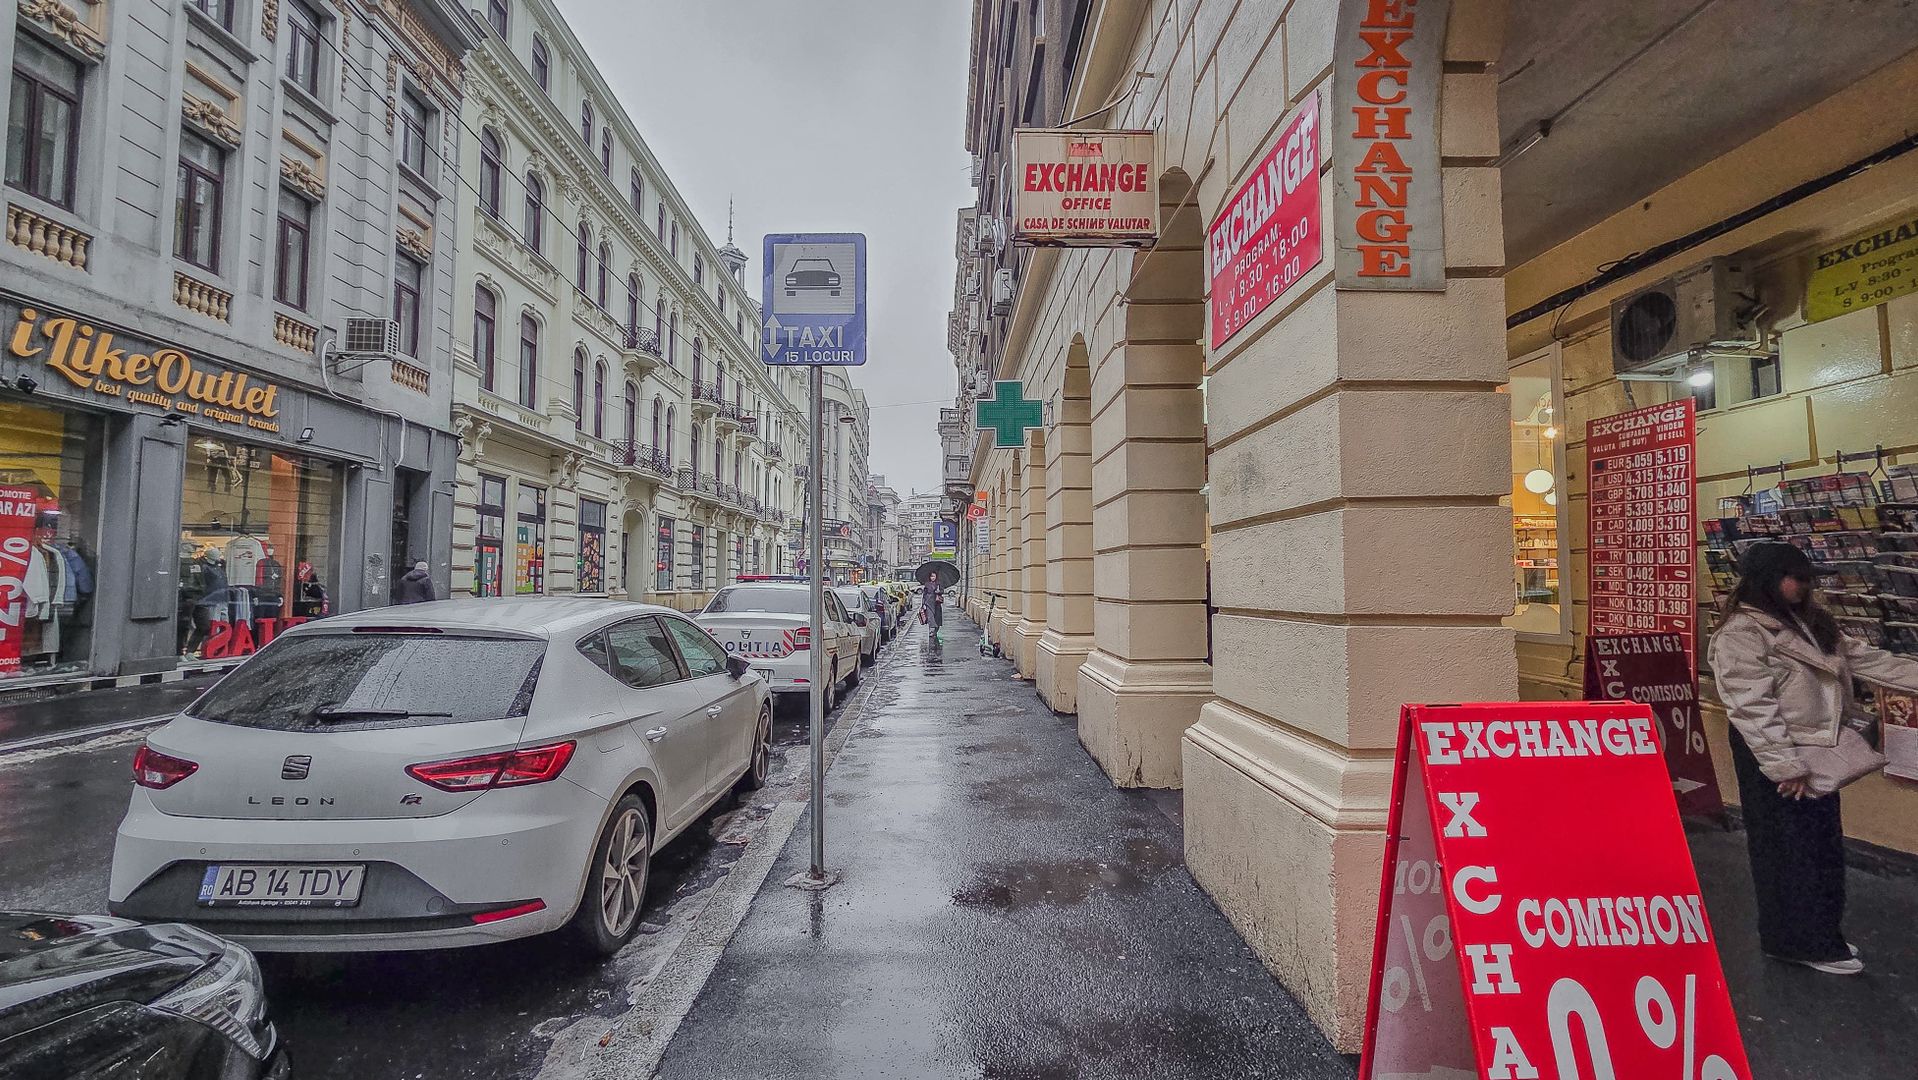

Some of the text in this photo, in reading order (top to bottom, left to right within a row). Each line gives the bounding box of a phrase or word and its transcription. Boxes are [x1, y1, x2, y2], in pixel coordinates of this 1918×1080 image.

[1352, 0, 1415, 277] EXCHANGE
[1024, 163, 1148, 193] EXCHANGE
[1212, 108, 1316, 278] EXCHANGE
[1062, 197, 1112, 210] OFFICE
[1024, 217, 1151, 230] CASA DE SCHIMB VALUTAR
[1240, 262, 1262, 298] 8:30
[1272, 216, 1308, 265] 18:00
[1224, 318, 1230, 335] S
[1234, 295, 1256, 328] 9:00
[1266, 255, 1300, 300] 16:00
[1842, 297, 1852, 308] S
[1860, 286, 1894, 303] 9:00
[783, 325, 843, 348] TAXI
[784, 350, 854, 363] 15 LOCURI
[95, 380, 280, 433] best quality and original brands
[1592, 405, 1686, 437] EXCHANGE
[1656, 420, 1684, 433] VINDEM
[1593, 443, 1616, 454] VALUTA
[1608, 459, 1624, 470] EUR
[1608, 474, 1623, 484] USD
[1608, 489, 1623, 499] GBP
[15, 502, 36, 517] AZI
[1608, 505, 1622, 514] CHF
[1608, 520, 1624, 530] CAD
[1608, 535, 1623, 544] ILS
[1609, 551, 1623, 560] TRY
[1608, 566, 1624, 576] SEK
[1609, 582, 1624, 590] MDL
[1609, 598, 1625, 608] NOK
[1609, 614, 1625, 623] DKK
[720, 641, 782, 652] OLITIA
[1595, 634, 1683, 656] EXCHANGE
[1632, 683, 1694, 703] COMISION
[1420, 717, 1658, 766] EXCHANGE
[248, 796, 335, 806] LEON
[200, 869, 353, 896] RO AB 14 TDY
[1516, 893, 1710, 948] COMISION
